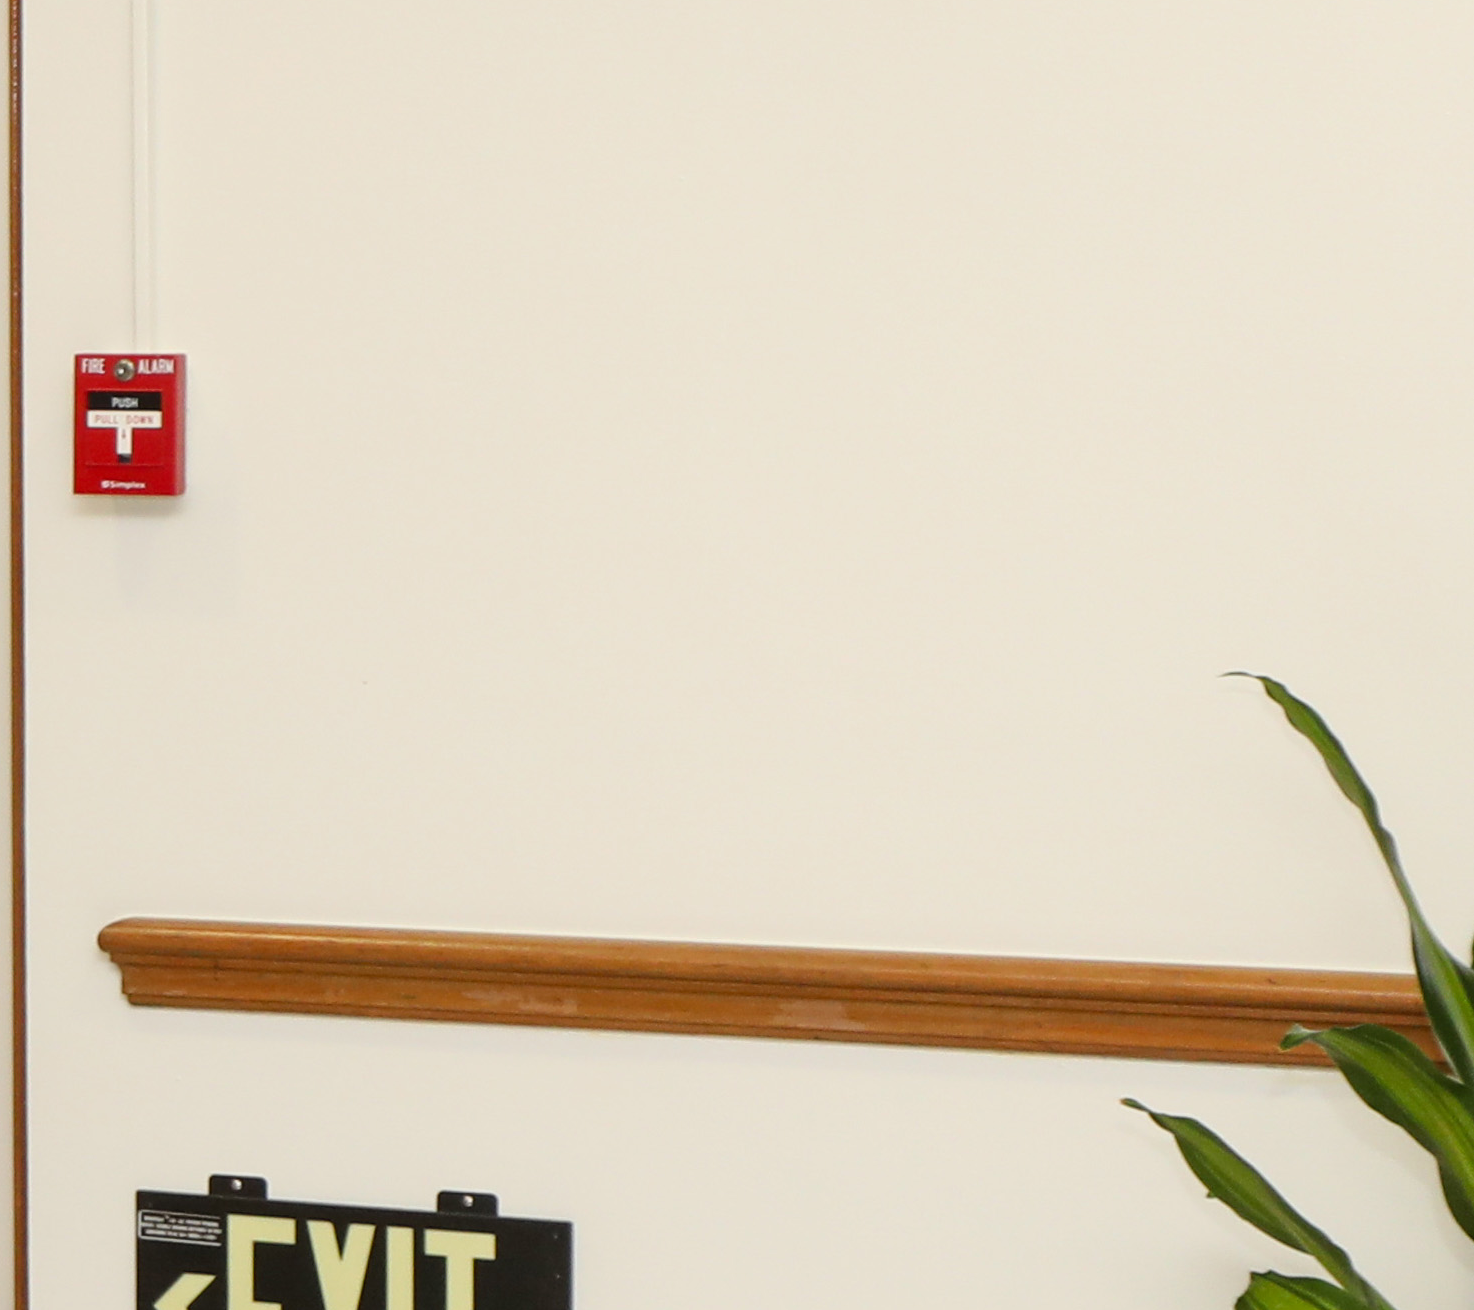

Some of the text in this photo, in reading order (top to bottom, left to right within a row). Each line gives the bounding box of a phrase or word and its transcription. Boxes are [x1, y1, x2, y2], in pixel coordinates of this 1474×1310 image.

[81, 358, 175, 374] FIRE ALARM
[111, 396, 139, 408] PUSH
[94, 414, 154, 425] PULL DOWN
